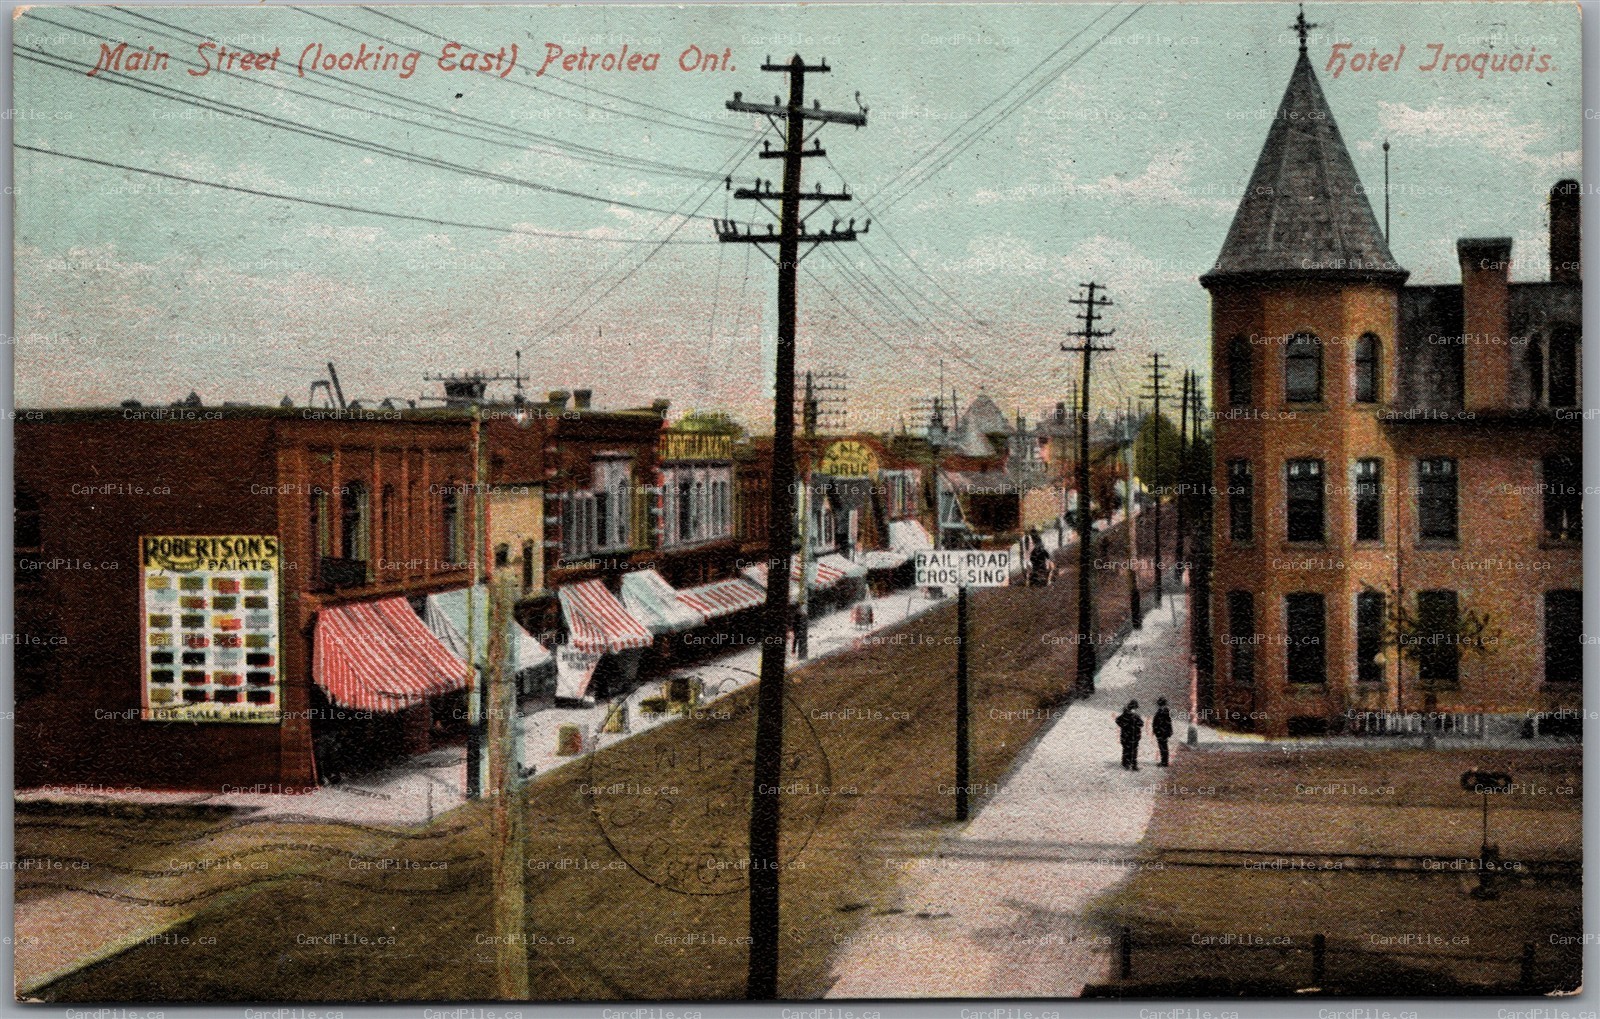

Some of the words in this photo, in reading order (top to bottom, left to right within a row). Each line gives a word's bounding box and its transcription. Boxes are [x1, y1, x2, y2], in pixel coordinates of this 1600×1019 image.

[208, 558, 272, 571] PAINTS
[917, 553, 957, 568] RAIL
[966, 553, 1008, 568] ROAD
[917, 569, 957, 583] CROS
[967, 569, 1005, 583] SING
